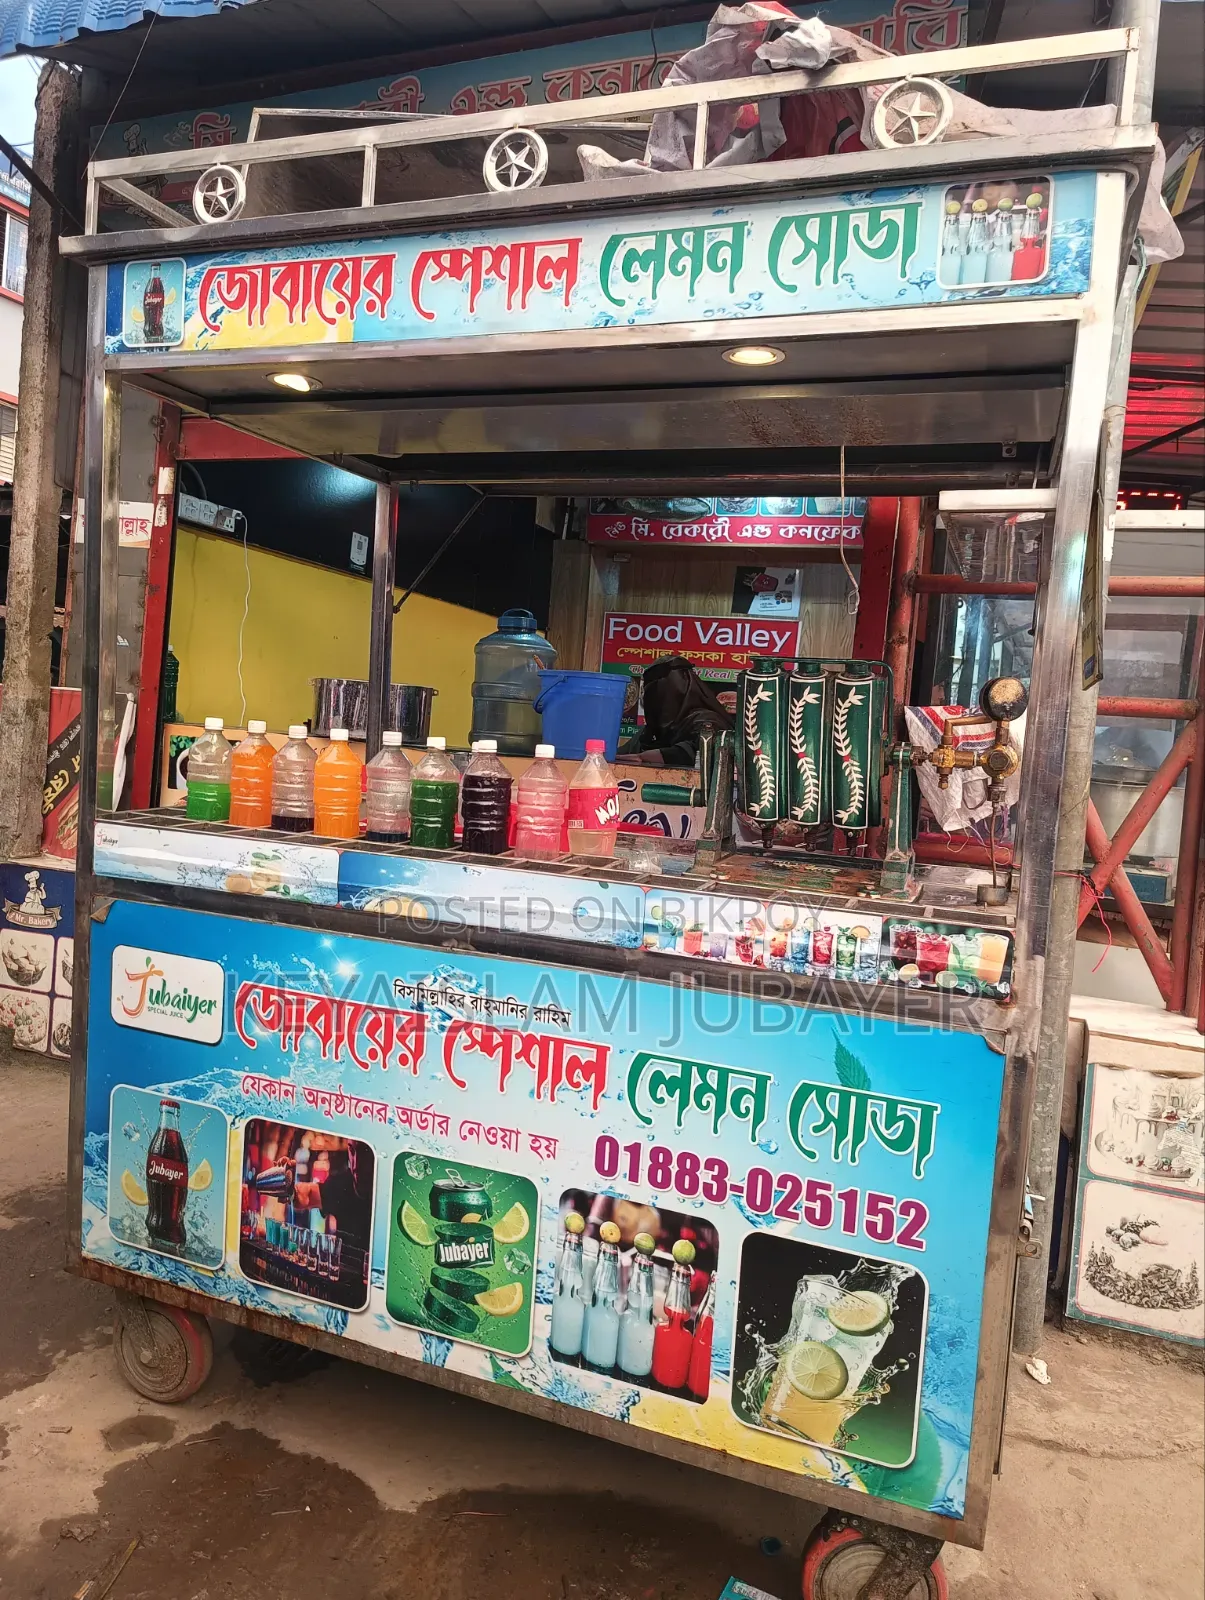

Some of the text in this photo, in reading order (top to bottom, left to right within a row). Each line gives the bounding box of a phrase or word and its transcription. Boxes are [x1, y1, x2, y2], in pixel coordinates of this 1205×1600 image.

[199, 201, 924, 332] জোবায়ের স্পেশাল লেমন সোডা
[662, 517, 733, 543] বেকারী
[736, 523, 772, 540] এন্ড
[607, 617, 792, 653] Food Valley
[121, 962, 217, 1023] Jubaiyer
[147, 1006, 184, 1019] SPECIAL JUICE
[533, 1003, 572, 1028] রাহিম
[235, 980, 941, 1178] জোবায়ের স্পেশাল লেমন সোডা
[302, 1084, 390, 1124] অনুষ্ঠানের
[396, 1103, 452, 1138] অর্ডার
[459, 1118, 521, 1152] নেওয়া
[528, 1132, 560, 1161] হয়
[148, 1159, 183, 1181] Jubayer
[593, 1134, 930, 1251] 01883-025152
[439, 1242, 489, 1263] Jubayer
